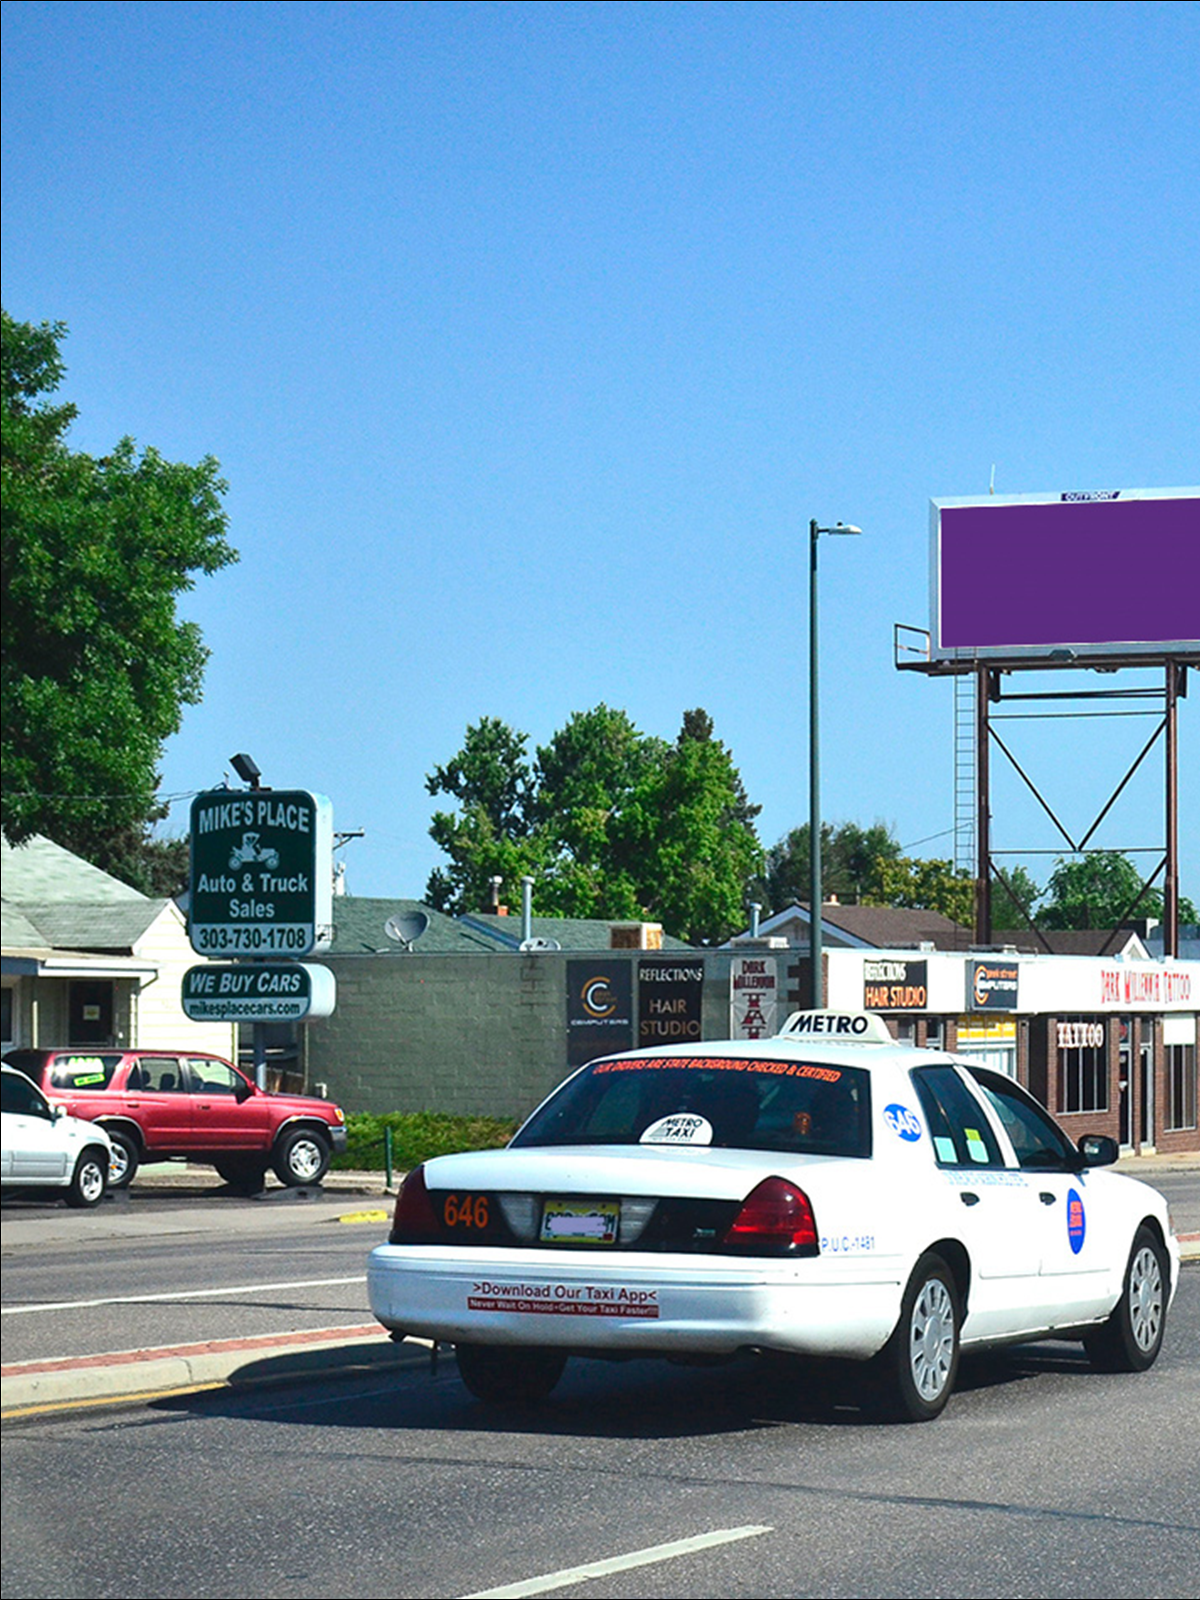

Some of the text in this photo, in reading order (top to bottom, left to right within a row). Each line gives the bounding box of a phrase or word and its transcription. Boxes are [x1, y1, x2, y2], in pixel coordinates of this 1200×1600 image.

[199, 801, 310, 834] MIKE'S PLACE
[198, 873, 308, 893] Auto & Truck
[229, 898, 275, 918] Sales
[200, 928, 306, 949] 303-730-1708
[190, 972, 300, 993] WE BUY CARS
[639, 967, 704, 982] REFLECTIONS
[649, 999, 688, 1014] HAIR
[865, 986, 926, 1007] HAIR STUDIO
[189, 1001, 300, 1018] mikesplacecars.com
[640, 1020, 701, 1036] STUDIO
[789, 1014, 869, 1035] METRO
[1057, 1023, 1104, 1048] TATTOO
[661, 1117, 704, 1128] METRO
[664, 1127, 697, 1138] TAXI
[883, 1110, 921, 1136] 646
[444, 1195, 490, 1229] 646
[555, 1285, 582, 1299] Our
[585, 1286, 615, 1300] Taxi
[470, 1299, 495, 1309] Never
[497, 1300, 517, 1309] Wait
[518, 1301, 532, 1311] On
[577, 1303, 598, 1313] Your
[599, 1304, 618, 1314] Taxi
